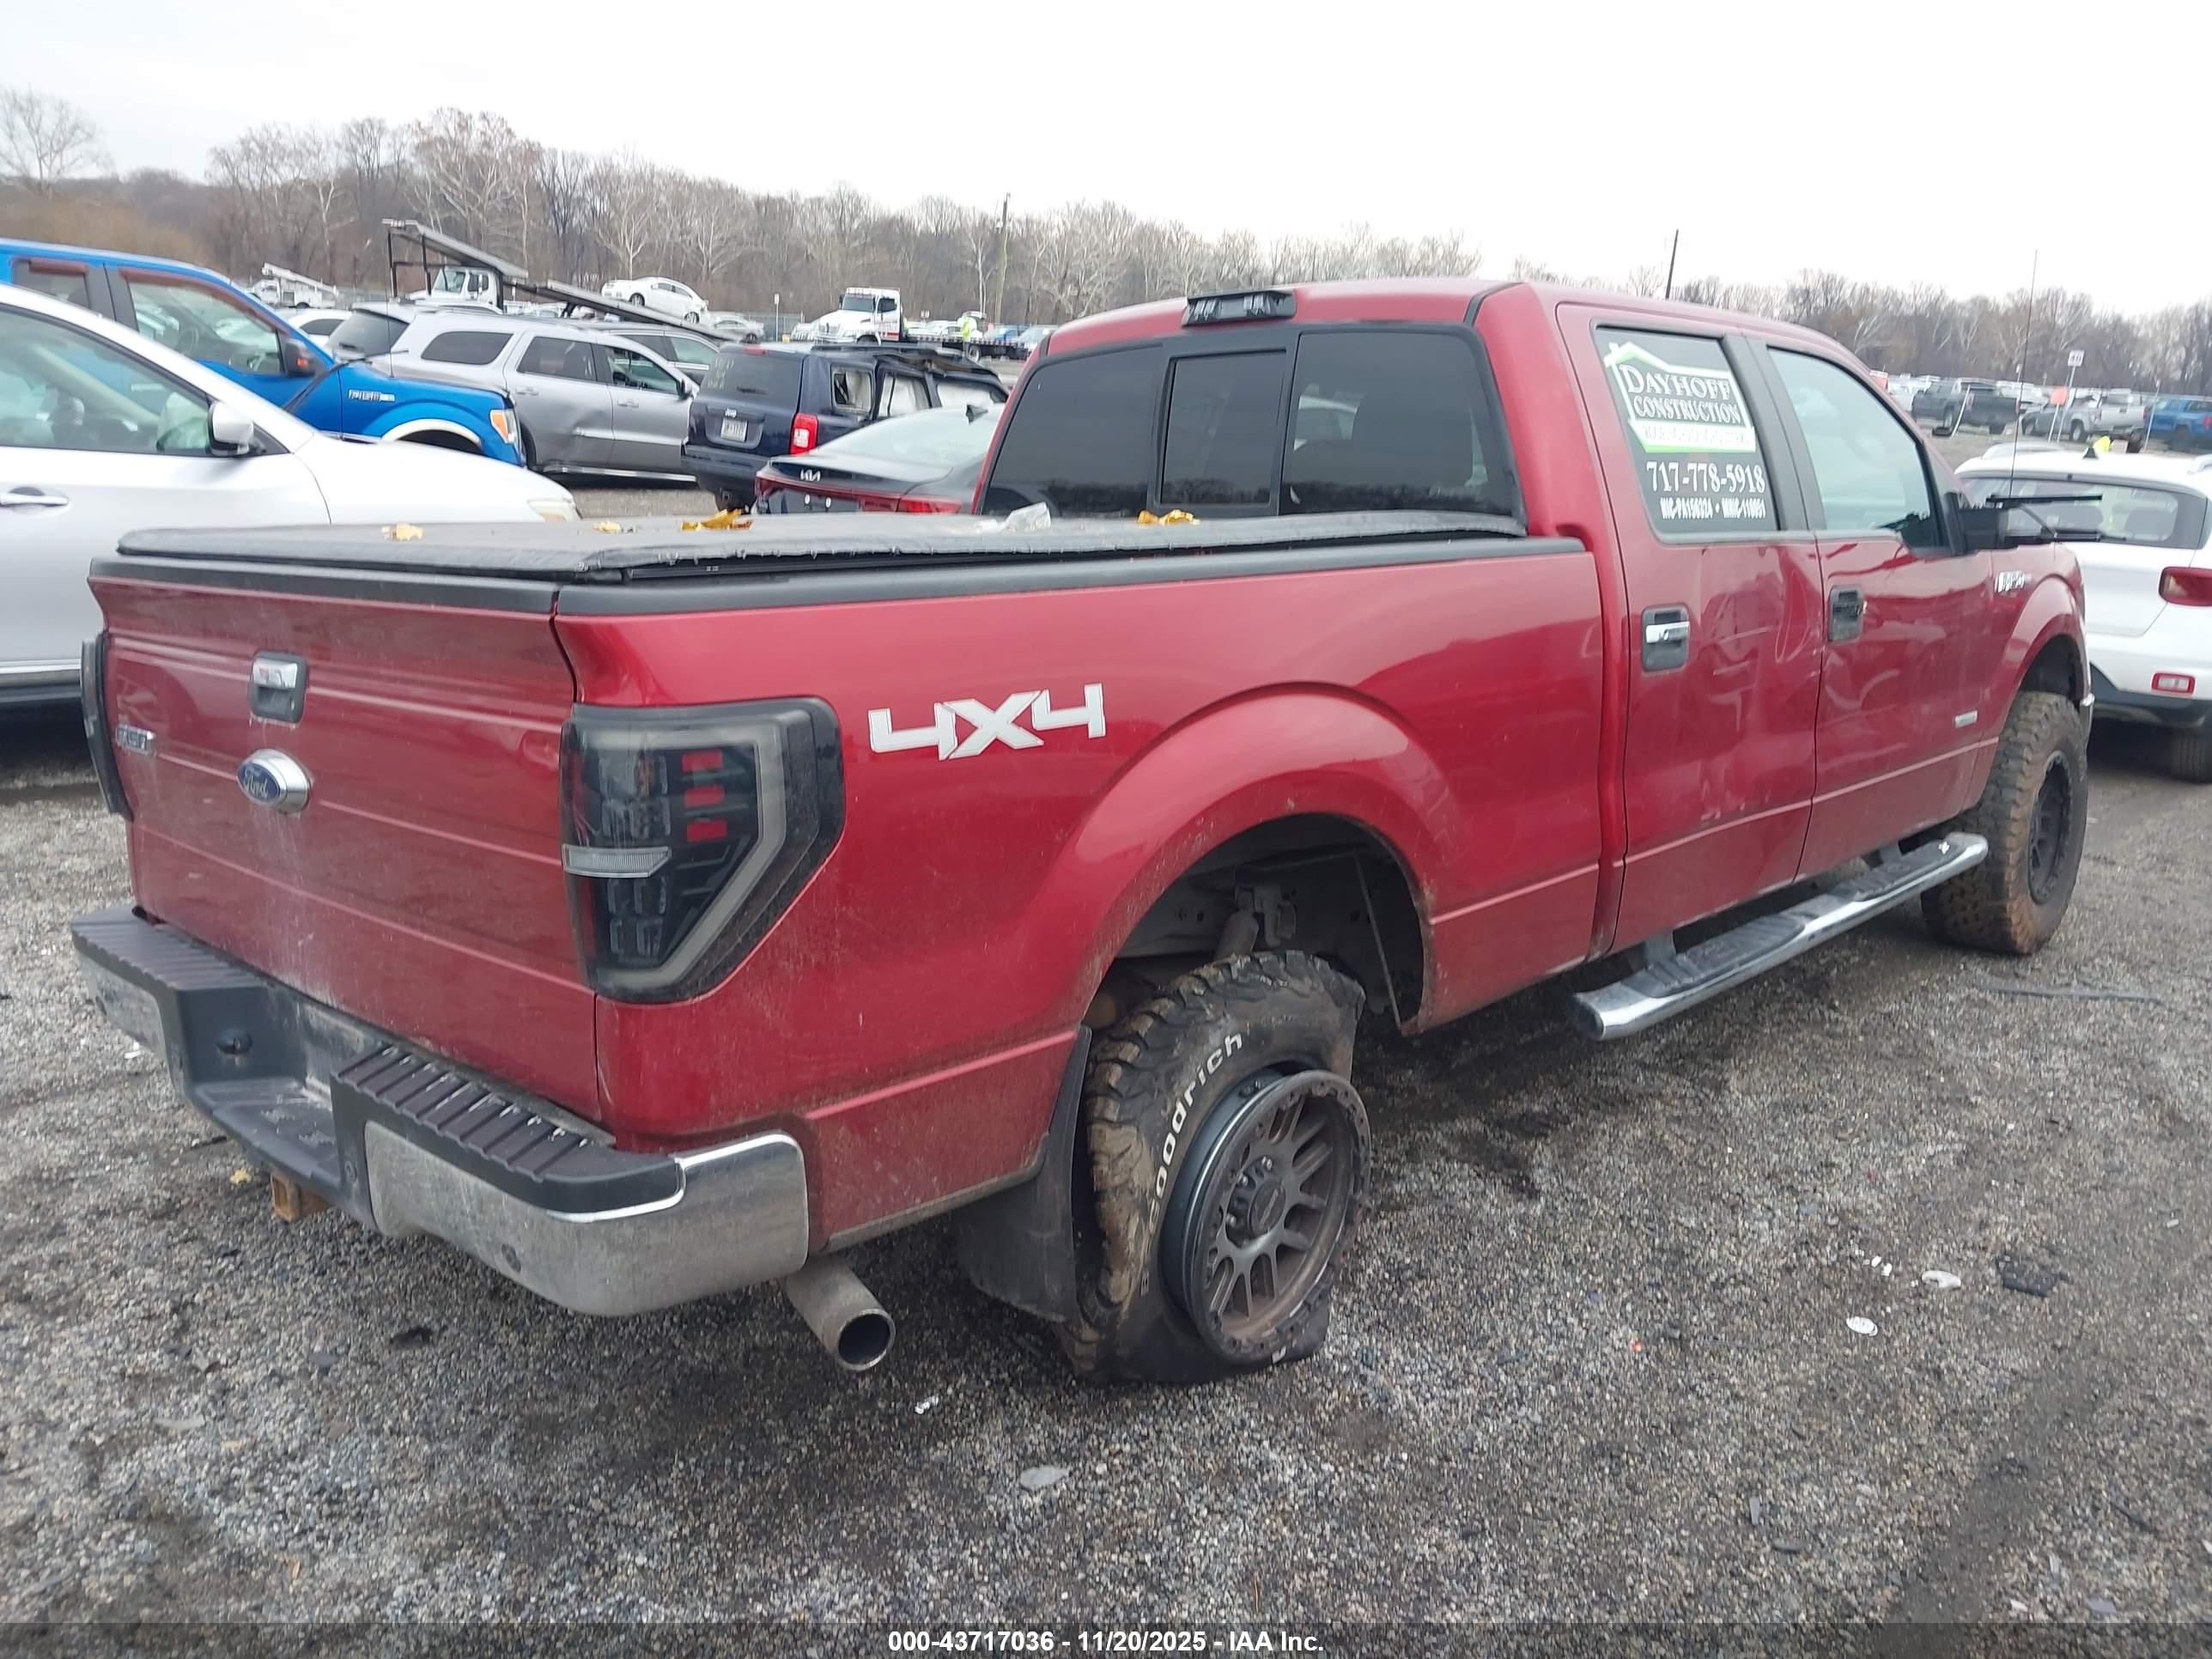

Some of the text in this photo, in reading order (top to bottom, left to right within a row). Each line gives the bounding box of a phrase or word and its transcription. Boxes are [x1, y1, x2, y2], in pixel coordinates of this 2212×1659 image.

[1619, 364, 1731, 400] DAYHOFF
[1633, 396, 1741, 424] CONSTRUCTION
[1646, 461, 1765, 494] 717-778-5918
[244, 768, 269, 799] Ford
